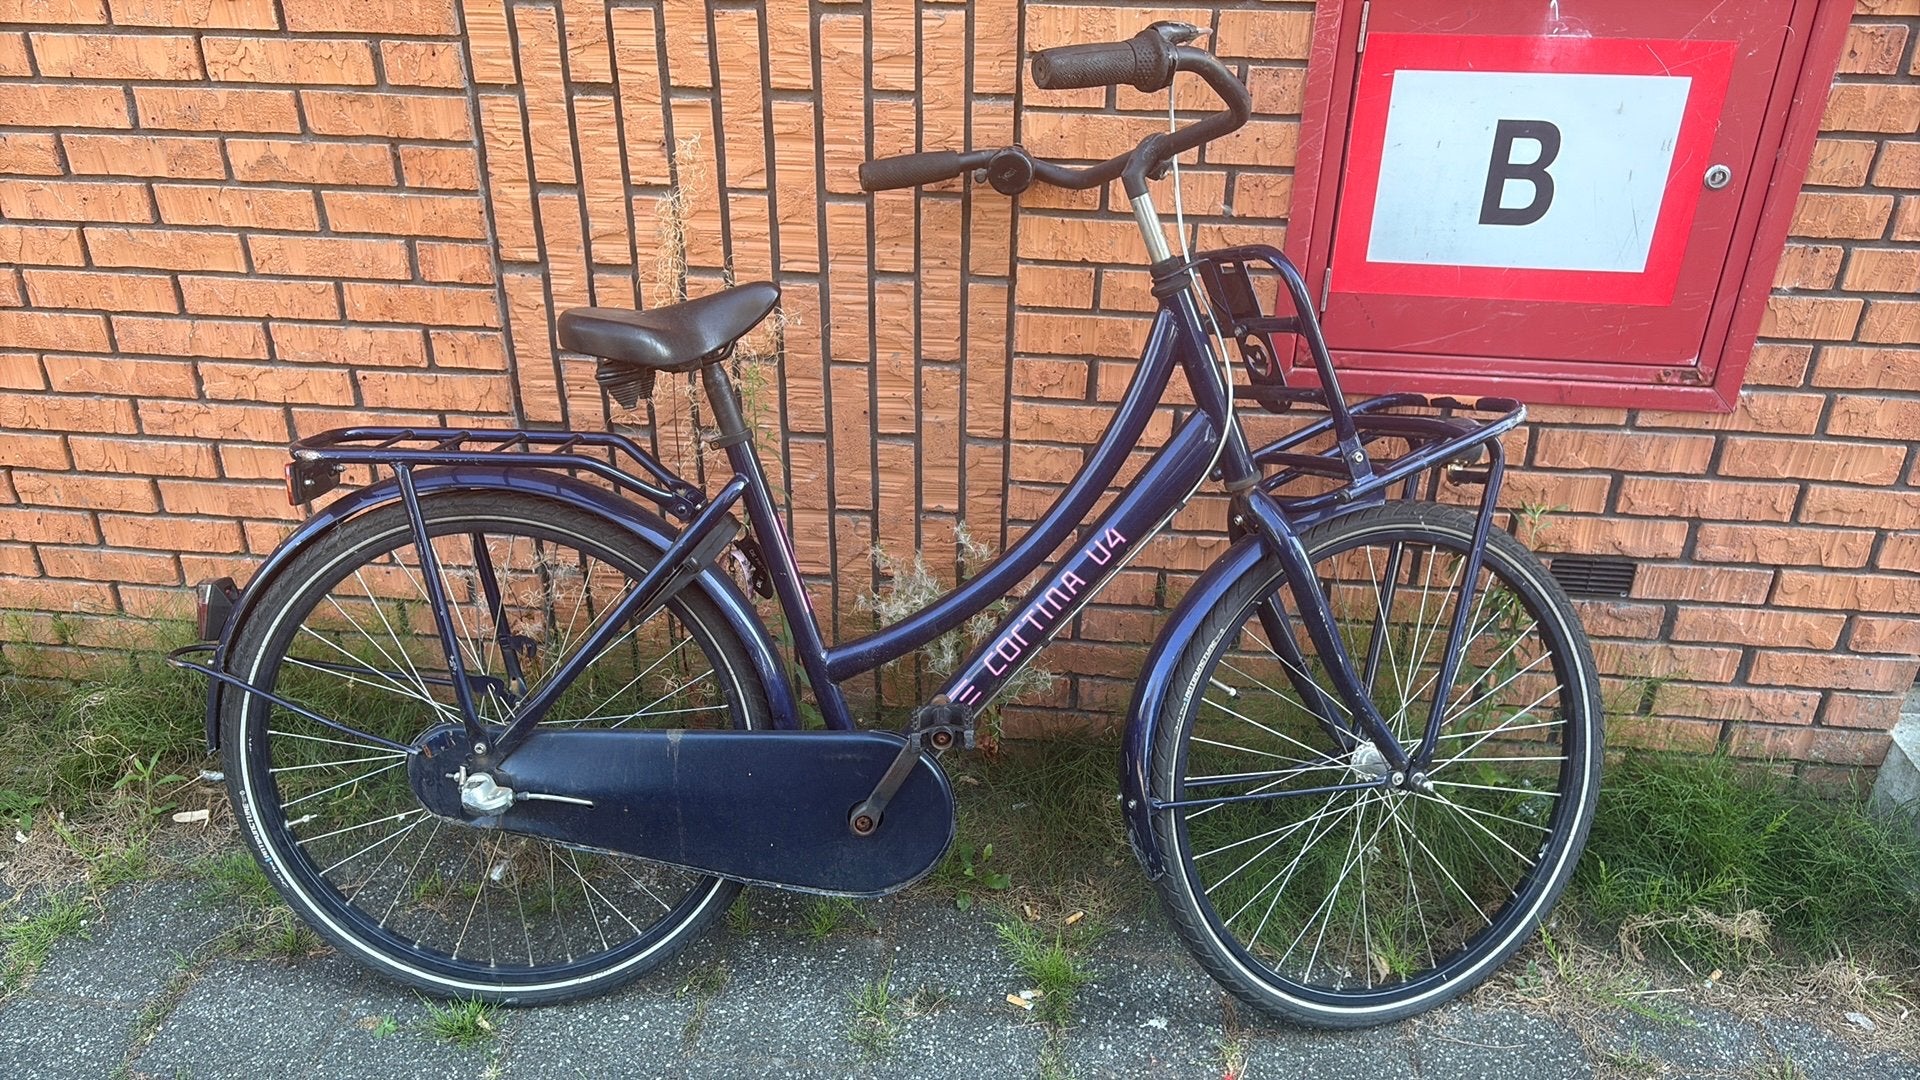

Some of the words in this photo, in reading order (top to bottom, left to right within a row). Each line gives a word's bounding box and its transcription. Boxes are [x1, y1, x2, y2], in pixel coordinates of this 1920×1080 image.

[1479, 119, 1561, 226] B
[983, 571, 1085, 675] CORTINA
[1085, 528, 1125, 565] U4
